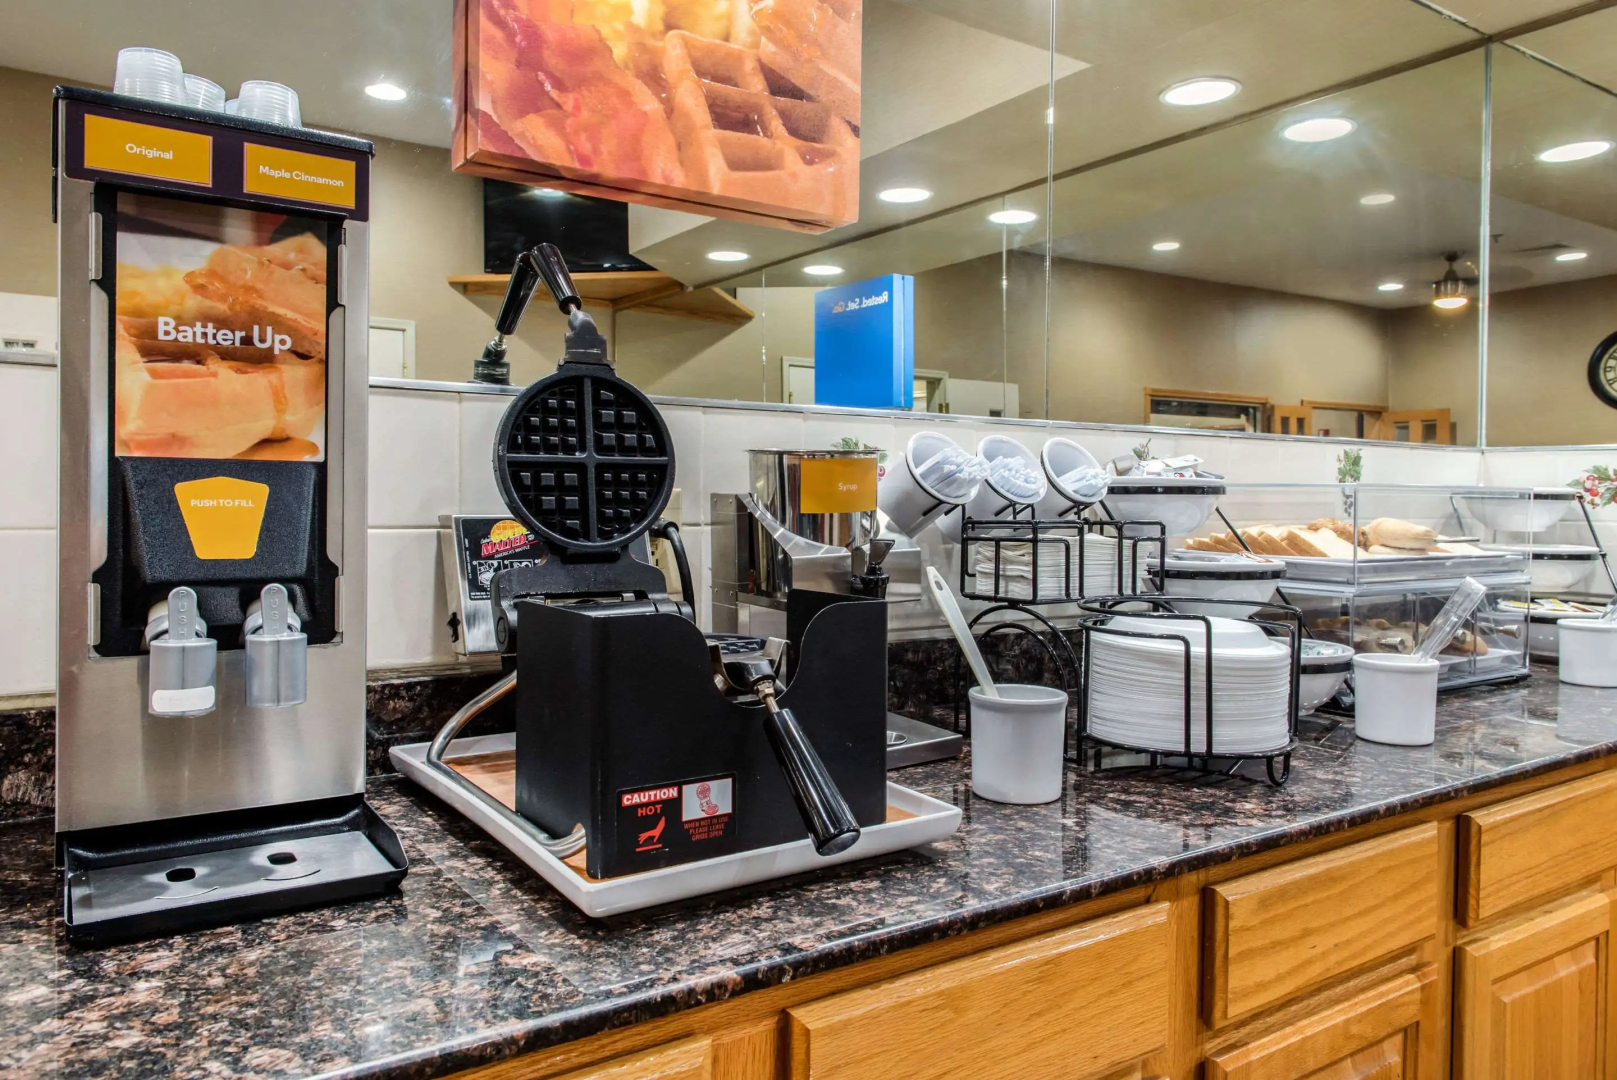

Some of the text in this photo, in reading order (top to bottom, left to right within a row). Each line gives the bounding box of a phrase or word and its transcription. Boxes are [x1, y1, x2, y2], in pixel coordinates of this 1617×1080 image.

[125, 143, 174, 160] Original
[259, 164, 344, 188] Maple Cinnamon
[157, 316, 292, 354] Batter Up
[837, 482, 858, 492] Syrup
[190, 499, 255, 507] PUSH TO FILL
[178, 590, 188, 637] PUSH
[270, 587, 279, 631] PUSH
[623, 787, 678, 805] CAUTION
[637, 804, 663, 817] HOT
[683, 821, 700, 830] WHEN
[700, 819, 711, 827] NOT
[718, 815, 729, 823] USE
[689, 823, 725, 835] PLEASE LEAVE
[691, 830, 723, 841] GRIDS OPEN
